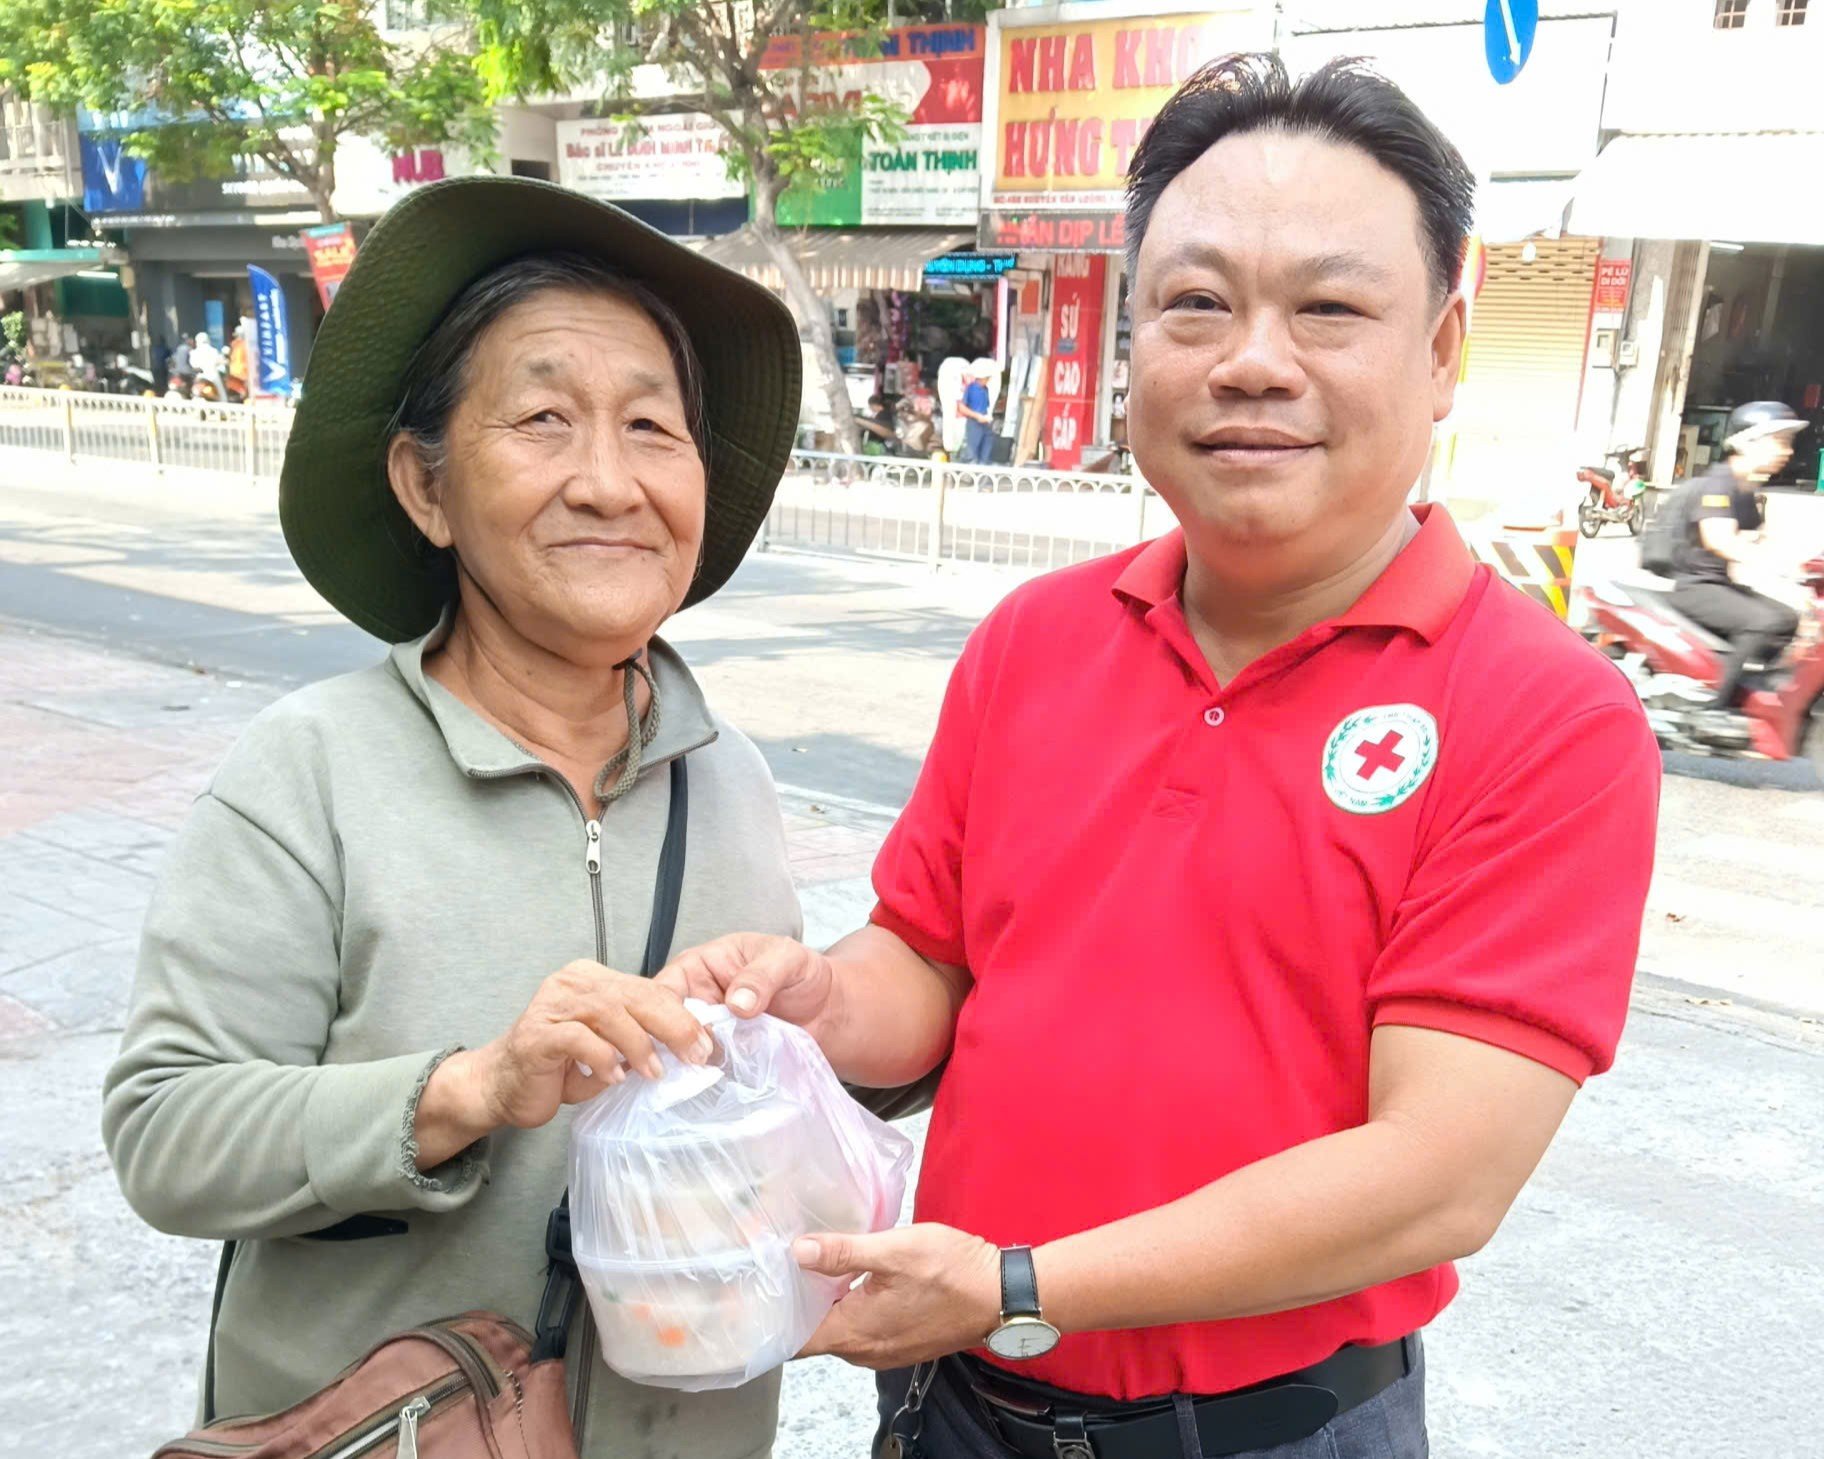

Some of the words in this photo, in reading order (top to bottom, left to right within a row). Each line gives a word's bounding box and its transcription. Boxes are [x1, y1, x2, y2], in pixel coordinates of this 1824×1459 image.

[1009, 34, 1095, 93] NHA
[922, 149, 977, 175] THỊNH
[1110, 118, 1150, 178] T
[1058, 219, 1095, 250] DỊP
[1054, 361, 1080, 395] CAO
